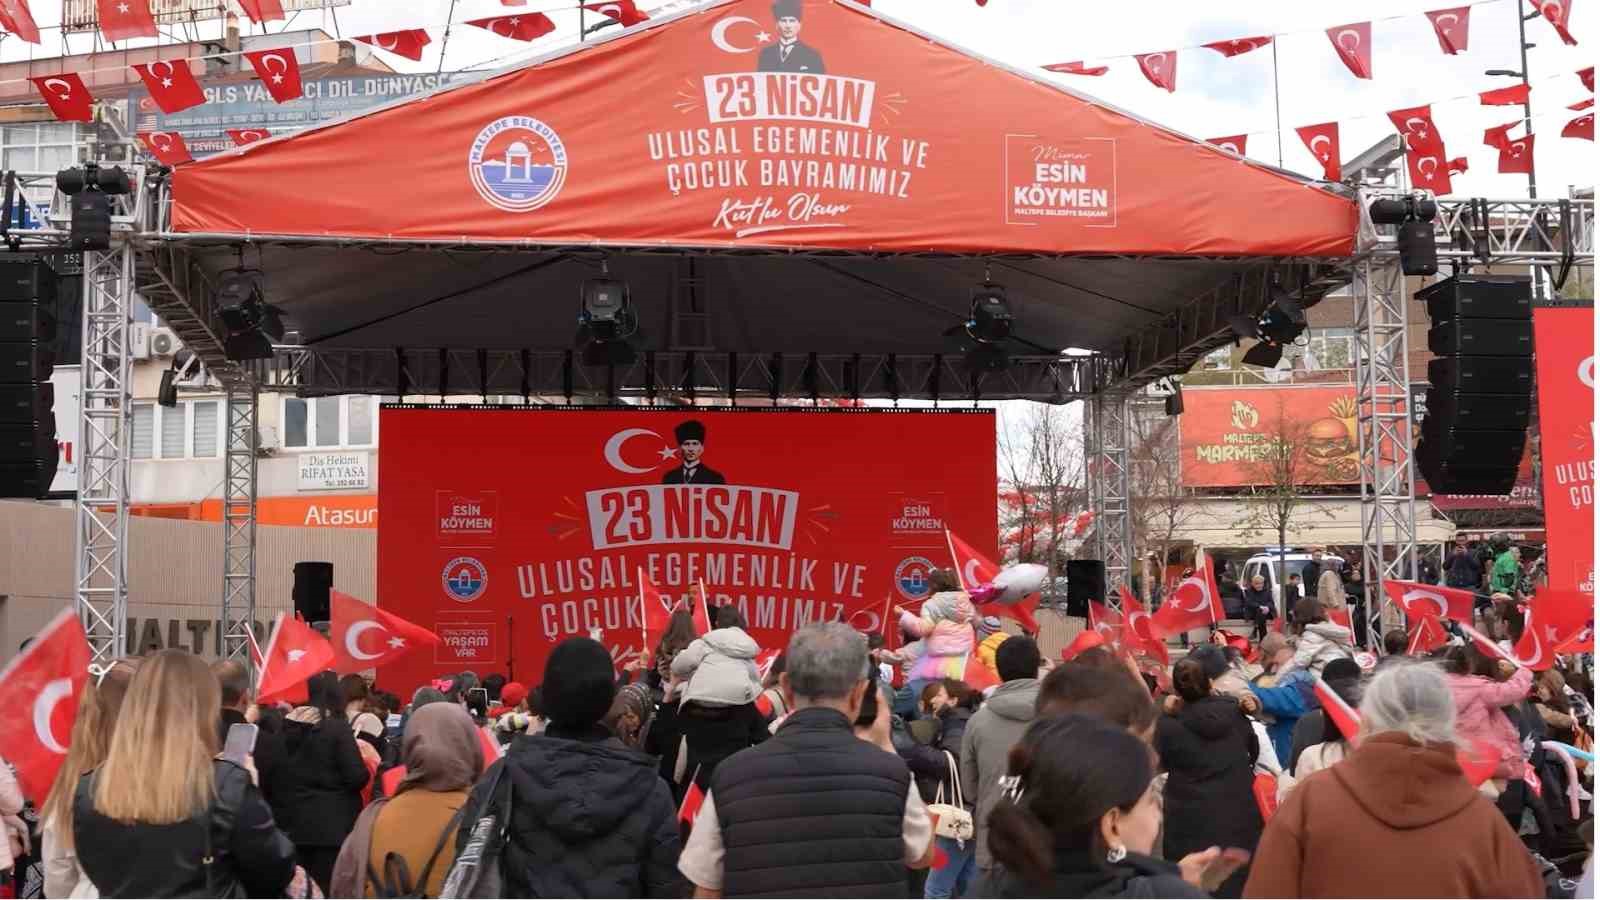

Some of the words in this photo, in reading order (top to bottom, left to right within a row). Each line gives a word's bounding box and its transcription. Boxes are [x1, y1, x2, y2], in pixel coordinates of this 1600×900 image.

[328, 79, 357, 98] DİL
[715, 76, 757, 119] 23
[472, 119, 509, 160] MALTEPE
[648, 127, 741, 160] ULUSAL
[753, 126, 890, 161] EGEMENLİK
[902, 138, 930, 168] VE
[667, 159, 749, 196] ÇOCUK
[760, 159, 912, 198] BAYRAMIMIZ
[1036, 160, 1086, 183] ESİN
[712, 196, 783, 230] Kutlu
[787, 192, 850, 221] Olsun
[1014, 183, 1108, 207] KÖYMEN
[441, 516, 493, 529] KÖYMEN
[453, 504, 481, 516] ESİN
[601, 489, 652, 544] 23
[892, 517, 942, 529] KÖYMEN
[904, 505, 930, 517] ESİN
[517, 555, 633, 599] ULUSAL
[647, 552, 818, 591] EGEMENLİK
[833, 562, 867, 598] VE
[541, 595, 642, 642] ÇOCUK
